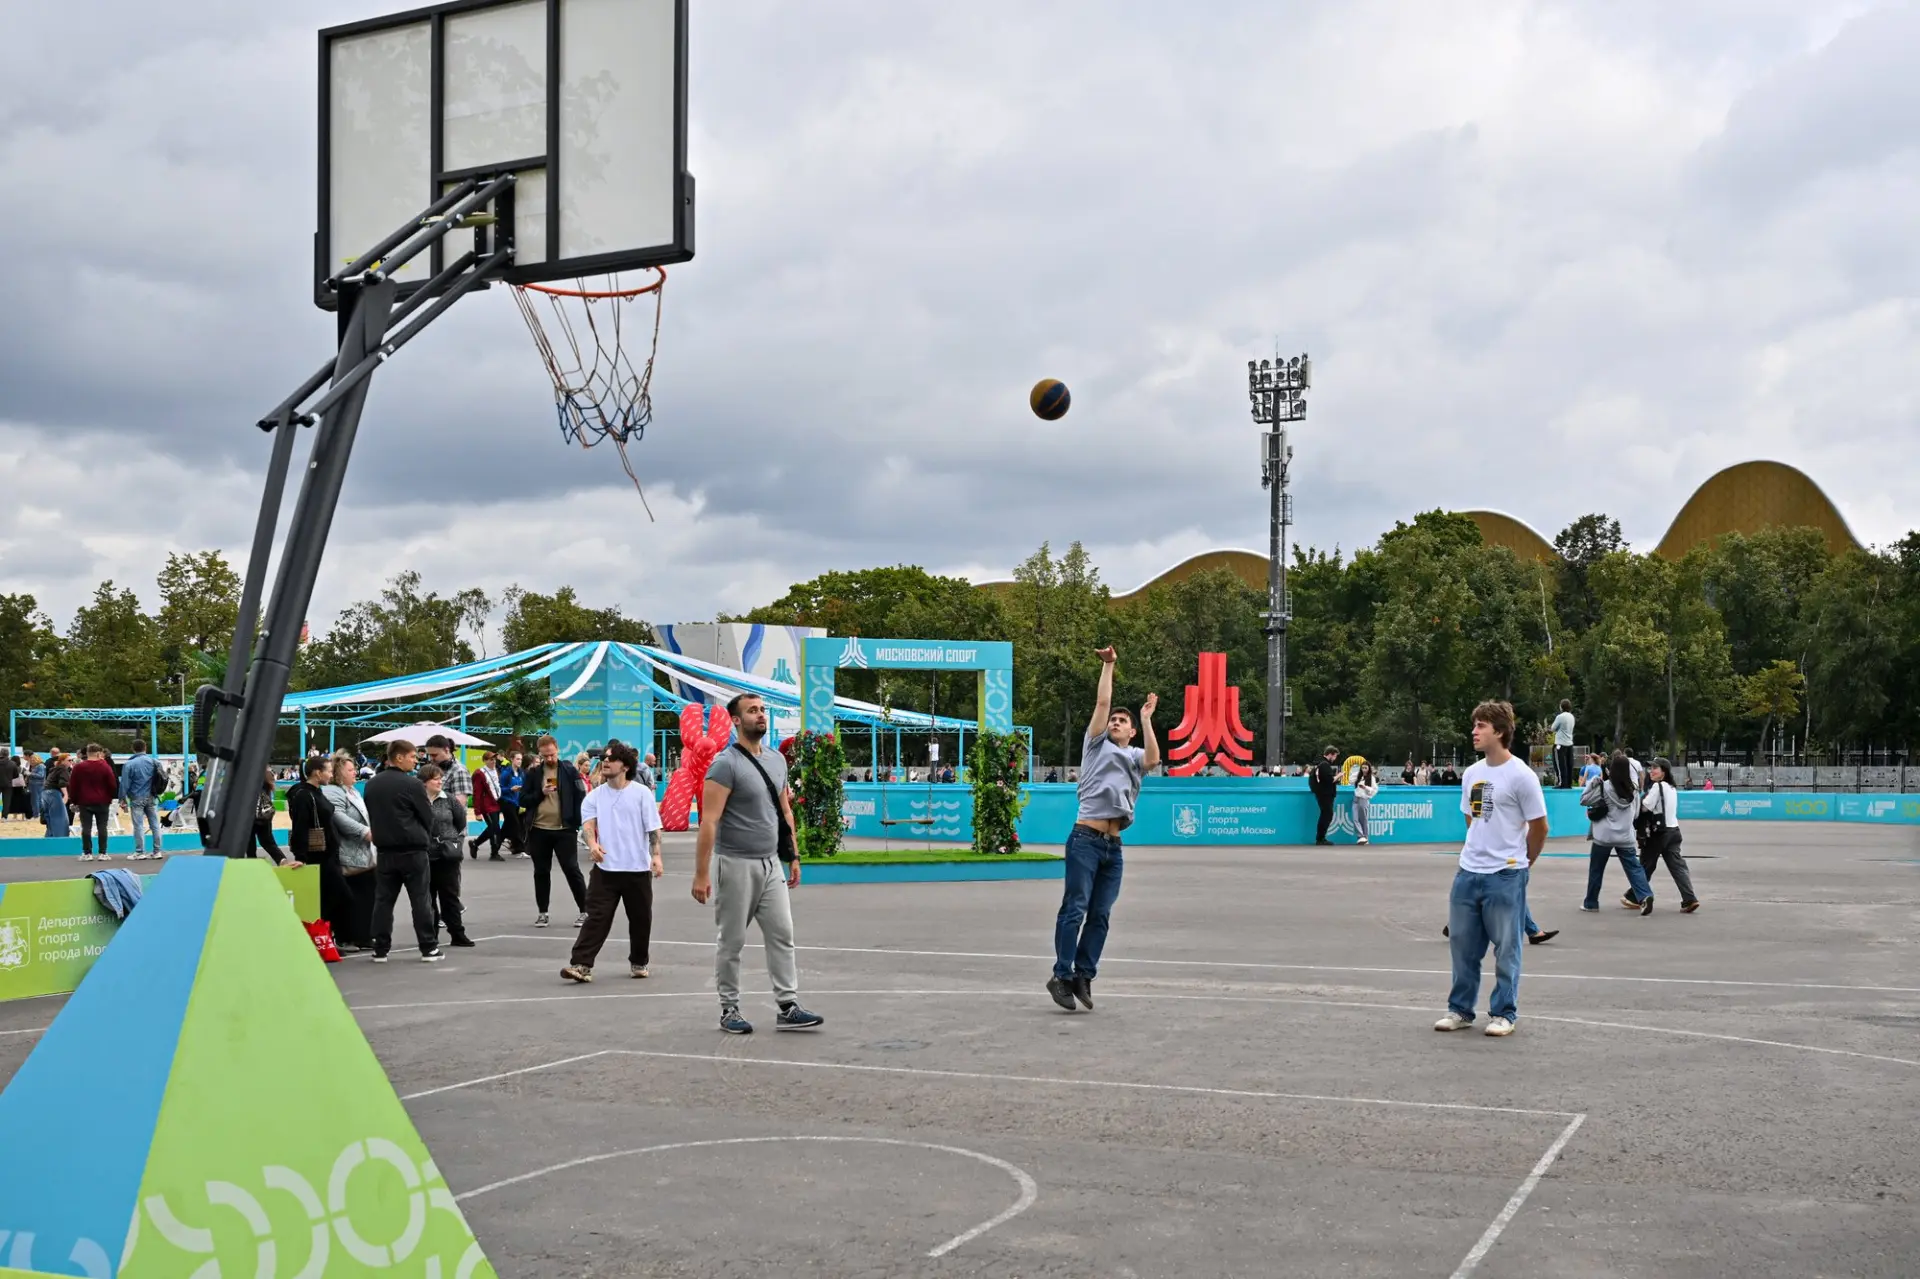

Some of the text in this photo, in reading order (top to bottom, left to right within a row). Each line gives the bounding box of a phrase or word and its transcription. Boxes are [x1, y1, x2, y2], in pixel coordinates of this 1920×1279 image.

[875, 646, 977, 663] МОСКОВСКИЙ СПОРТ
[1207, 805, 1268, 815] Департамент
[1207, 817, 1239, 826] спорта
[1367, 820, 1395, 836] ПОРТ
[1207, 826, 1276, 836] города Москвы
[38, 932, 80, 946] спорта
[39, 948, 81, 963] города
